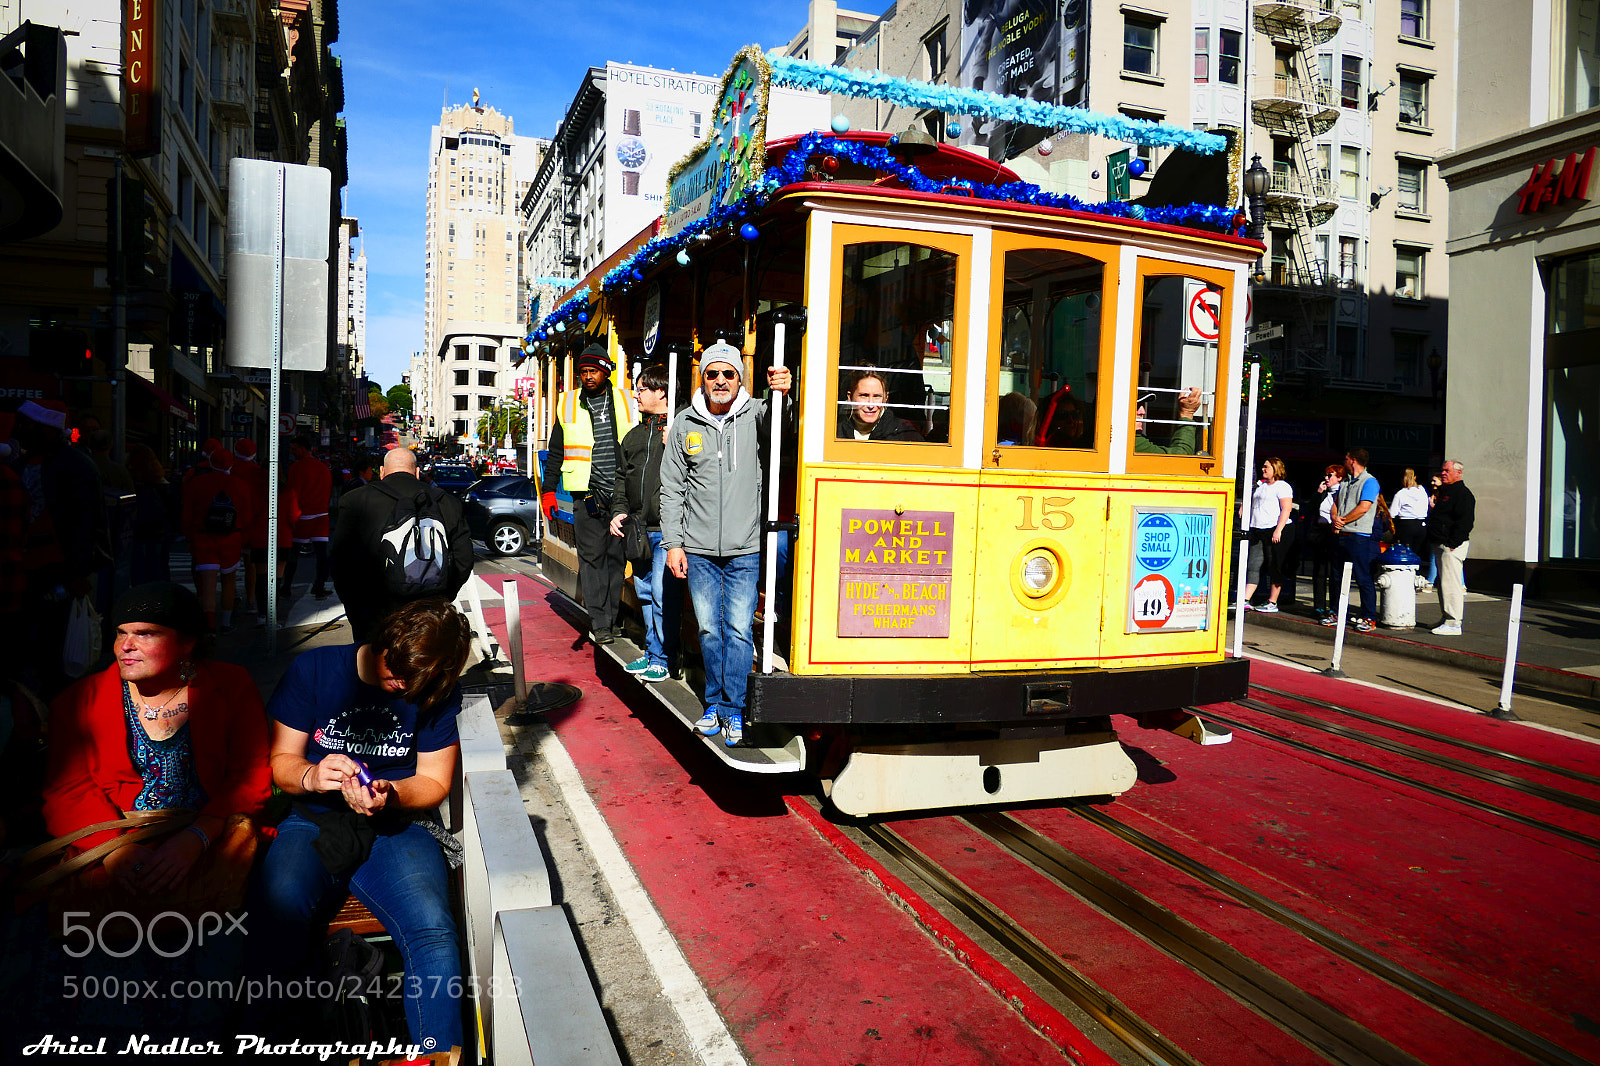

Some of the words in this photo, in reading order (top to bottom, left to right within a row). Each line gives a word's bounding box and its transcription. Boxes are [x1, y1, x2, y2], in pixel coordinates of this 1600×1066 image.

[1001, 9, 1030, 36] BELUGA
[998, 28, 1022, 52] NOBLE
[1010, 56, 1035, 79] MADE
[610, 69, 650, 86] HOTEL
[653, 75, 722, 97] STRATFORD
[1517, 146, 1597, 214] H&M
[1014, 495, 1076, 531] 15
[847, 518, 947, 537] POWELL
[1184, 516, 1210, 536] SHOP
[873, 535, 923, 549] AND
[1144, 532, 1171, 542] SHOP
[1183, 536, 1209, 557] DINE
[844, 548, 948, 565] MARKET
[1141, 542, 1172, 553] SMALL
[1181, 558, 1208, 579] 49
[845, 581, 881, 600] HYDE
[902, 583, 946, 601] BEACH
[853, 603, 938, 617] FISHERMANS
[1137, 598, 1162, 616] 49
[873, 616, 917, 629] WHARF
[346, 741, 411, 757] volunteer
